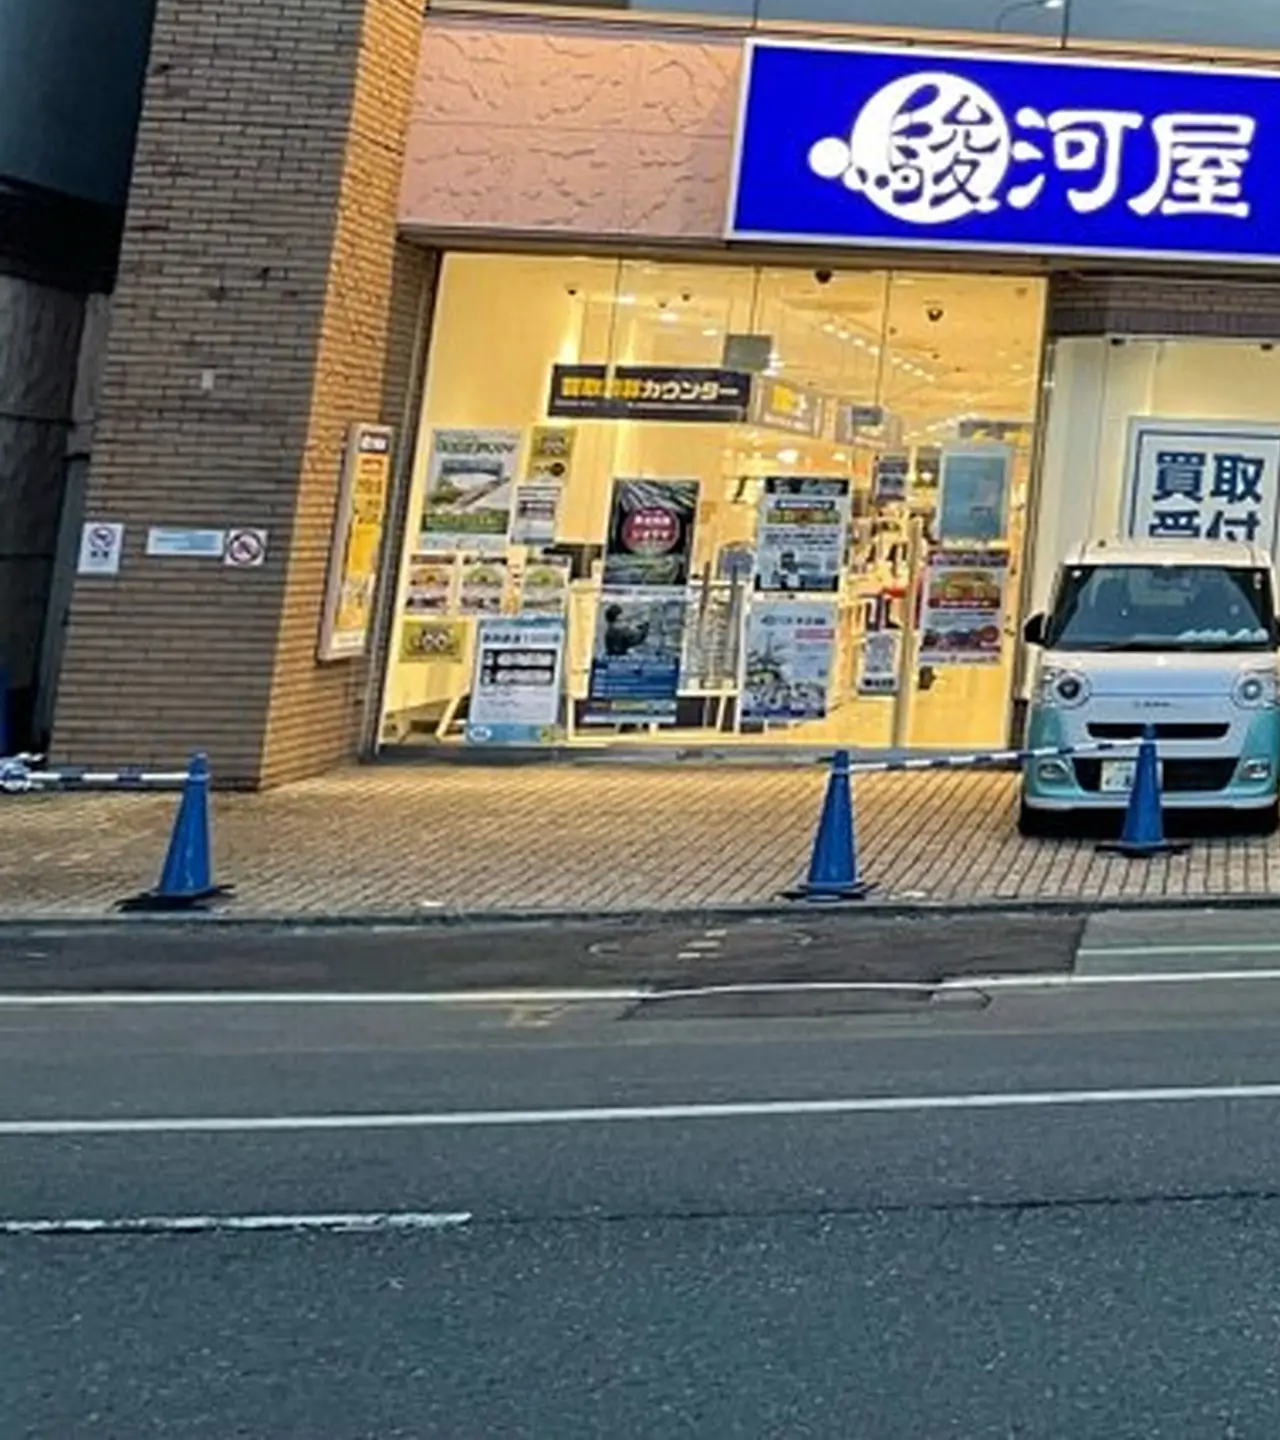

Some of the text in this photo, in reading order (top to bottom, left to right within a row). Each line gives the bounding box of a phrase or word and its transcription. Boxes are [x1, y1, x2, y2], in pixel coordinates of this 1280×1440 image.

[862, 76, 1257, 220] 駿河屋
[1152, 451, 1266, 504] 買取
